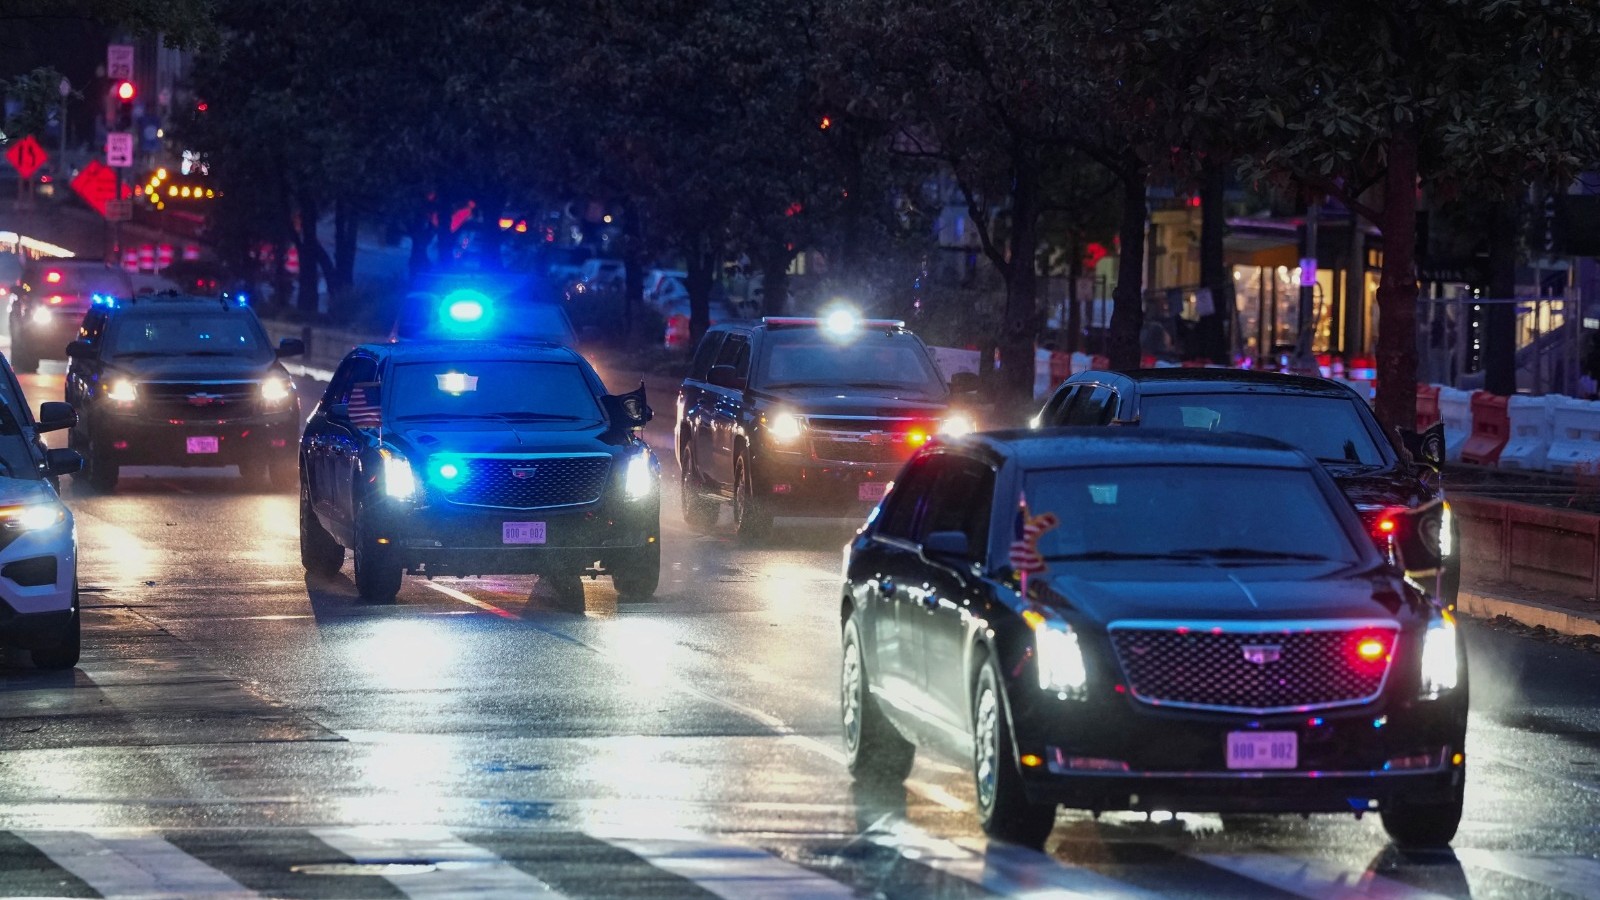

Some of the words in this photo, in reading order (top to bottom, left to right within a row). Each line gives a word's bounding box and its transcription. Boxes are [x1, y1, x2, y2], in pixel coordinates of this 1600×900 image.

[505, 528, 520, 538] 800
[529, 528, 544, 538] 002
[1233, 743, 1254, 759] 800
[1271, 742, 1292, 759] 002
